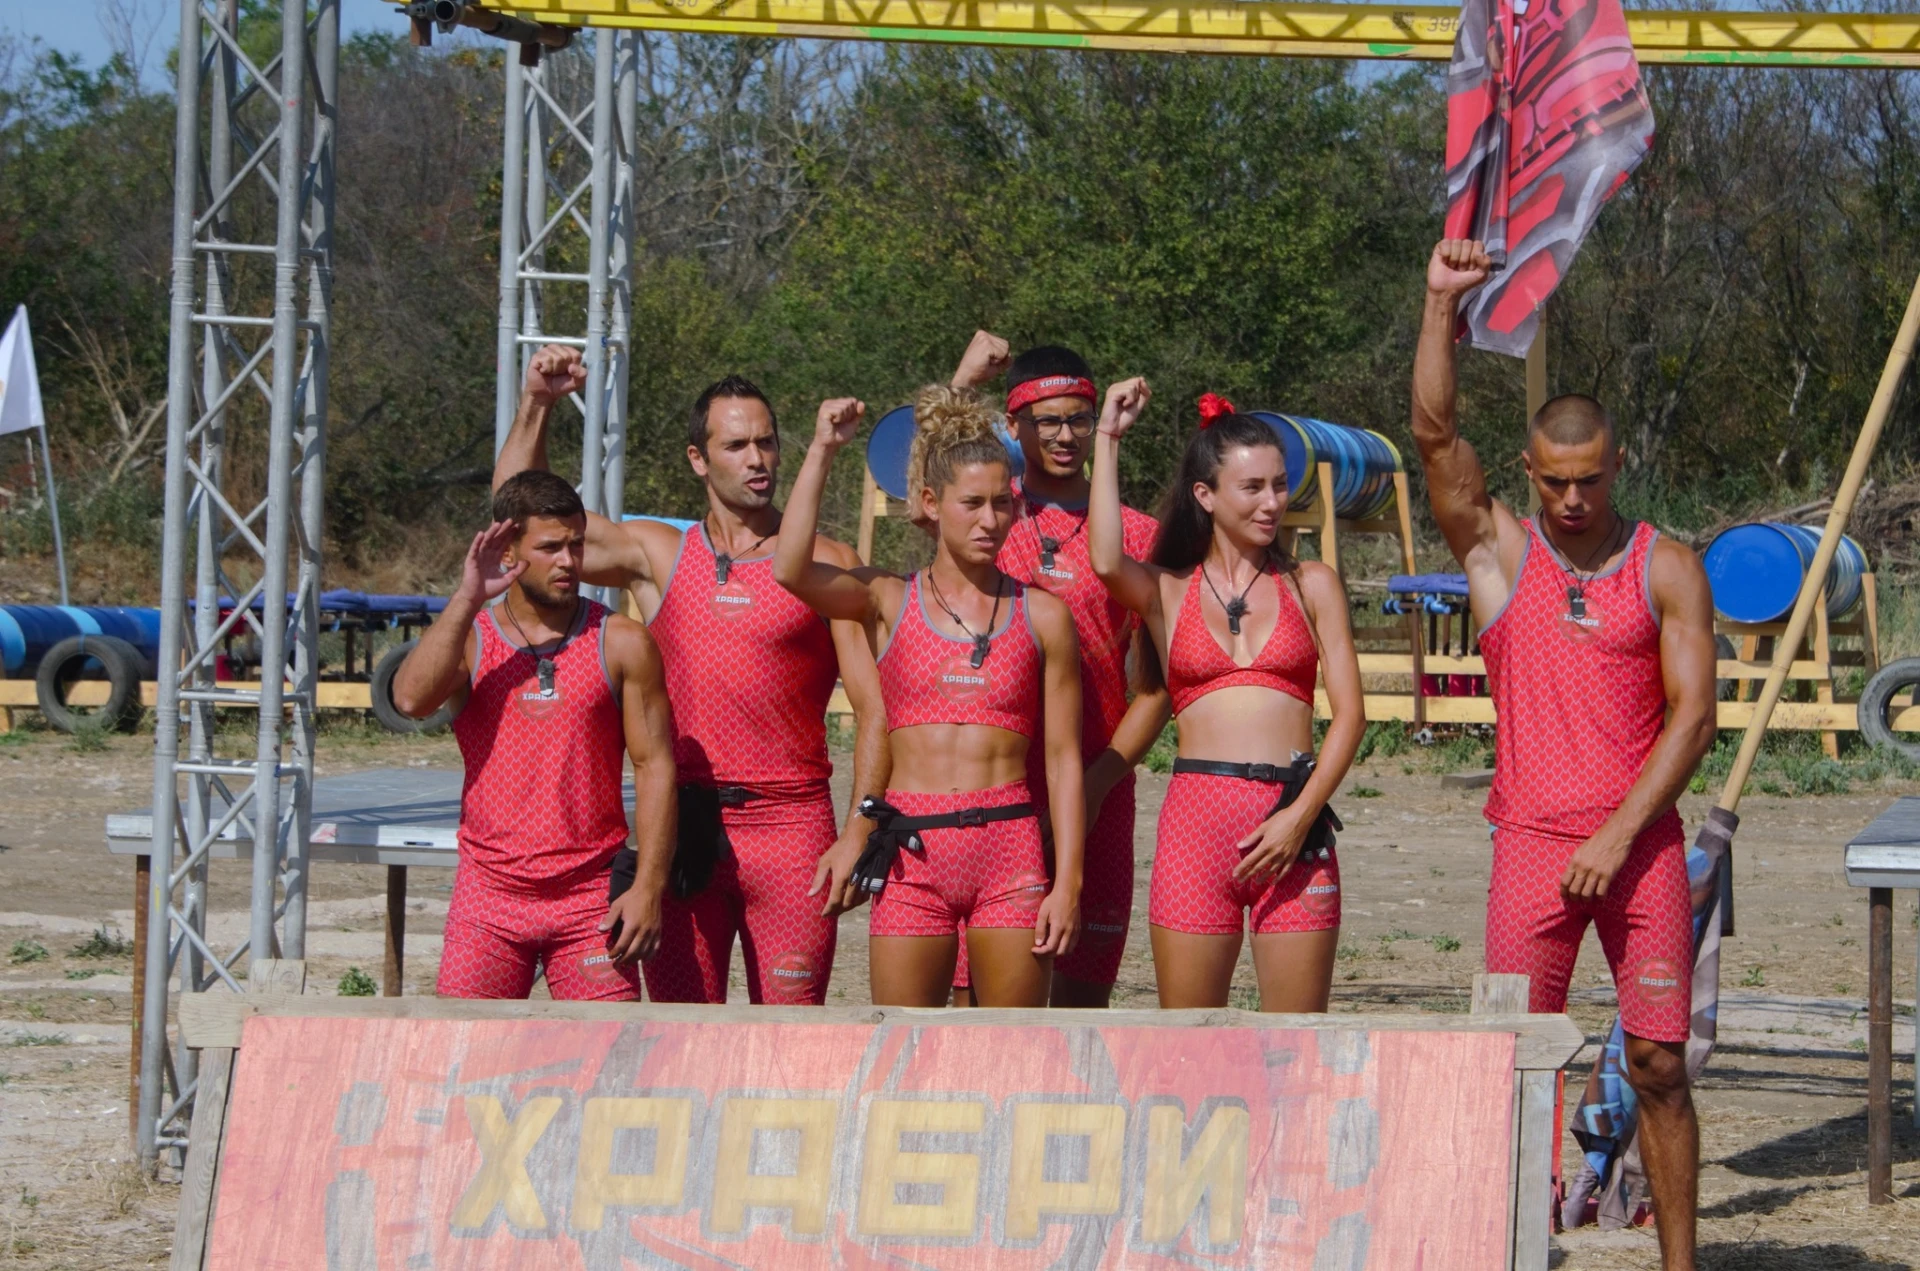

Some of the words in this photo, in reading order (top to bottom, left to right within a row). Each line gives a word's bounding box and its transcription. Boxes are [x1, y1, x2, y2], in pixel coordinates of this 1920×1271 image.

[1040, 377, 1079, 388] ХРАБРИ
[715, 595, 751, 605] ХРАБРИ
[1563, 613, 1600, 627] ХРБРИ
[942, 674, 985, 685] ХРАБРИ
[773, 968, 812, 978] ХРАБРИ
[1639, 976, 1678, 987] ХРАБРИ
[449, 1095, 1250, 1245] ХРАБРИ
